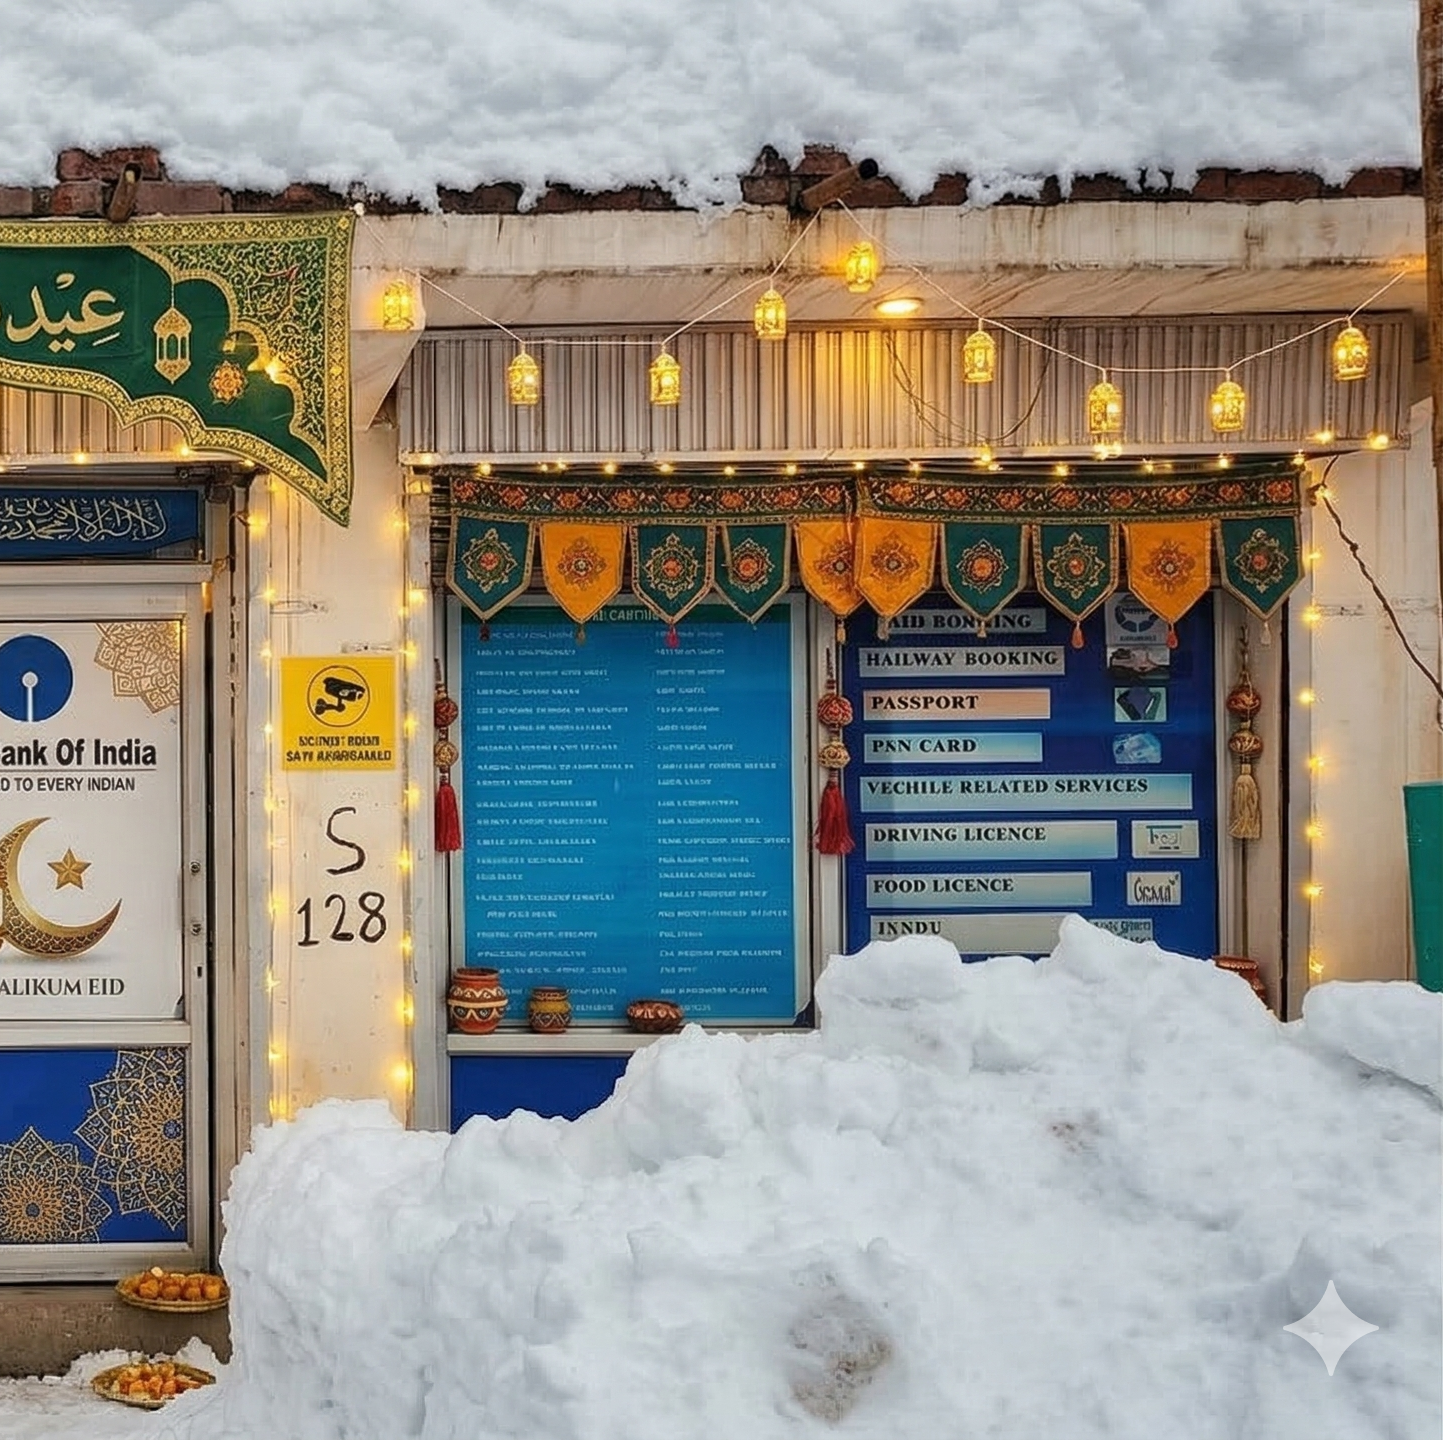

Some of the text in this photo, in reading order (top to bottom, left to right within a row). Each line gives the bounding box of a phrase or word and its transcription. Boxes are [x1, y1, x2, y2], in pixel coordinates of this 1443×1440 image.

[965, 651, 1058, 666] BOOKING
[871, 695, 979, 710] PASSPORT
[56, 738, 85, 766] Of
[94, 738, 157, 766] India
[919, 739, 977, 753] CARD
[14, 778, 33, 792] TO
[37, 777, 84, 791] EVERY
[88, 777, 135, 791] INDIAN
[867, 779, 1148, 795] VECHILE RELATED SERVICES
[325, 806, 366, 875] S
[873, 827, 1046, 842] DRIVING LICENCE
[873, 878, 1014, 893] FOOD LICENCE
[297, 891, 387, 947] 128
[88, 978, 125, 996] EID
